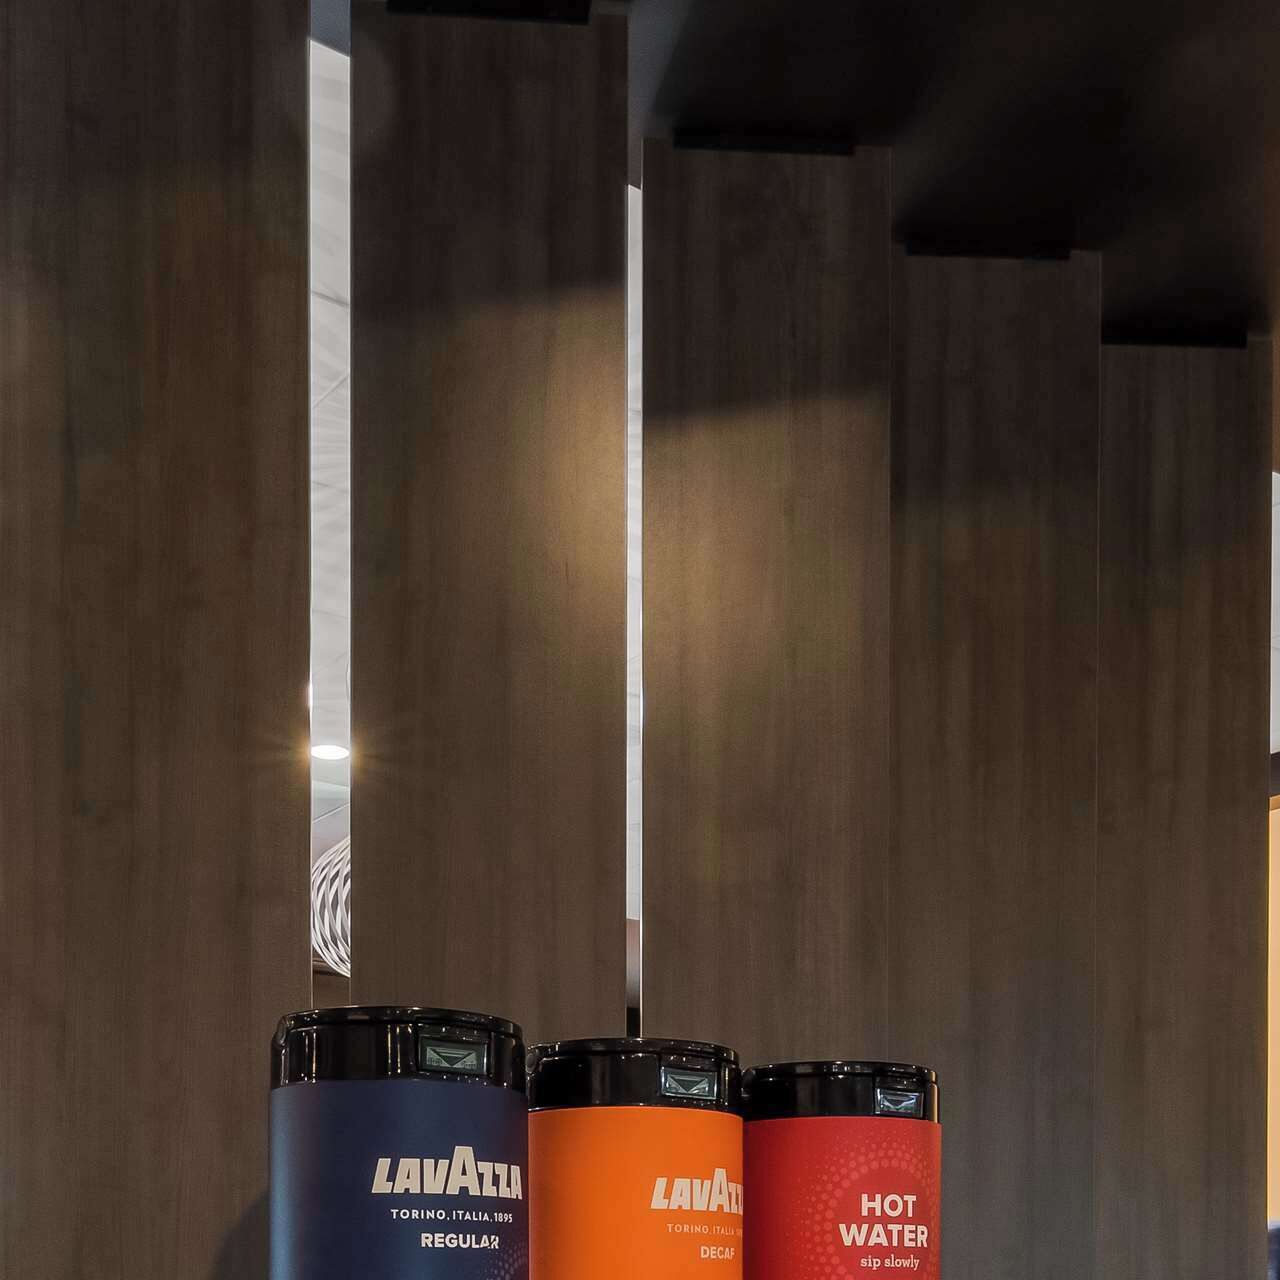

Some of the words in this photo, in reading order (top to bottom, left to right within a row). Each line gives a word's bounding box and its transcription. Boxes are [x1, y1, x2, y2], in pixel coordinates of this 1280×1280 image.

[371, 1145, 523, 1200] LAVAZZA
[861, 1193, 917, 1217] HOT
[421, 1232, 500, 1249] REGULAR
[839, 1223, 928, 1248] WATER
[700, 1246, 736, 1260] DECAF
[860, 1255, 881, 1270] sip
[884, 1253, 920, 1270] slowly
